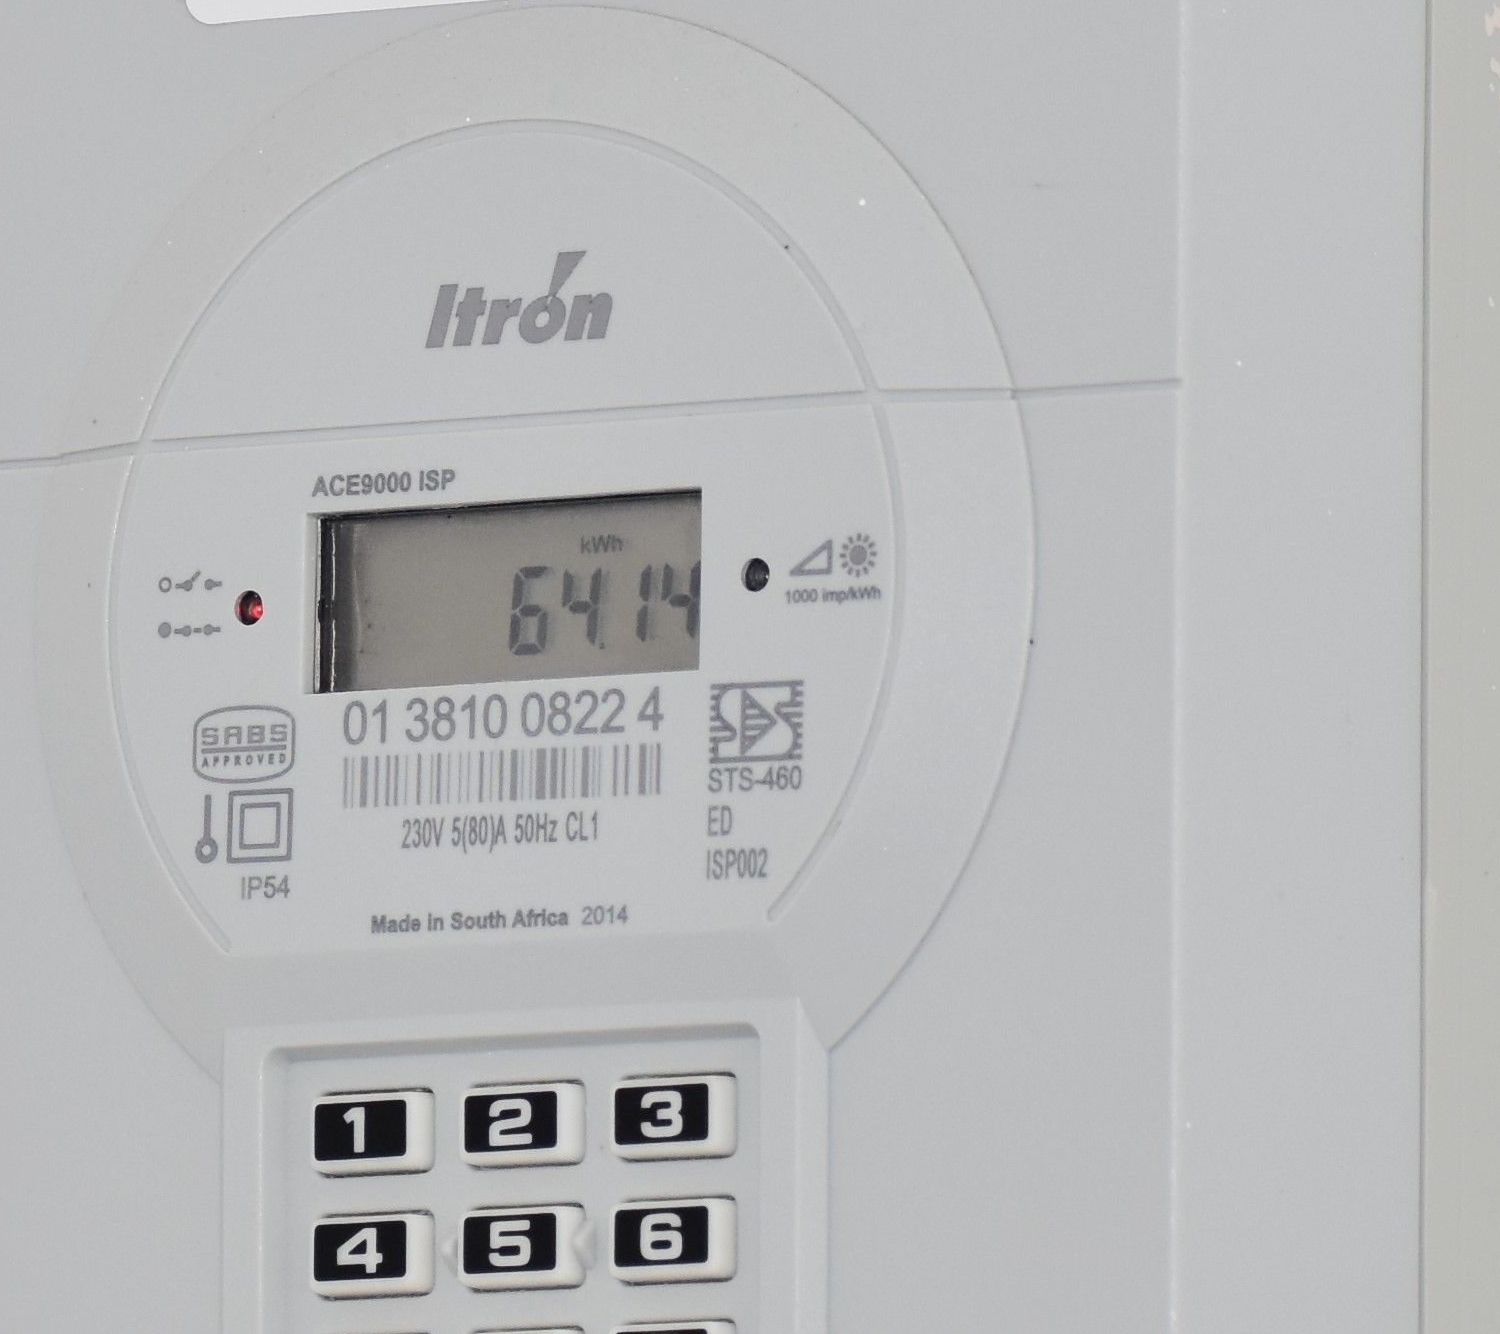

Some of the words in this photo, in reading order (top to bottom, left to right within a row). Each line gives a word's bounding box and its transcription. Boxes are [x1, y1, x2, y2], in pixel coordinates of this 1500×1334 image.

[425, 251, 613, 348] Itron
[312, 471, 412, 497] ACE9000
[419, 469, 456, 491] ISP
[580, 534, 624, 554] kWh
[785, 588, 818, 604] 1000
[822, 586, 882, 605] imp/kWh
[343, 699, 388, 745] 01
[405, 694, 508, 742] 3810
[521, 688, 626, 737] 0822
[637, 686, 664, 731] 4
[201, 723, 287, 746] SABS
[201, 753, 286, 768] APPROVED
[708, 765, 802, 793] STS-460
[401, 817, 444, 849] 230V
[451, 814, 507, 854] 5(80)A
[514, 813, 558, 843] 50Hz
[565, 811, 598, 841] CL1
[707, 804, 733, 837] ED
[706, 848, 768, 881] ISP002
[241, 875, 290, 900] IP54
[371, 914, 421, 934] Made
[427, 912, 444, 931] in
[450, 910, 506, 931] South
[512, 908, 568, 928] Africa
[581, 905, 628, 926] 2014
[343, 1106, 365, 1153] 1
[488, 1098, 533, 1148] 2
[640, 1091, 683, 1138] 3
[336, 1227, 383, 1274] 4
[488, 1220, 531, 1267] 5
[640, 1212, 683, 1260] 6
